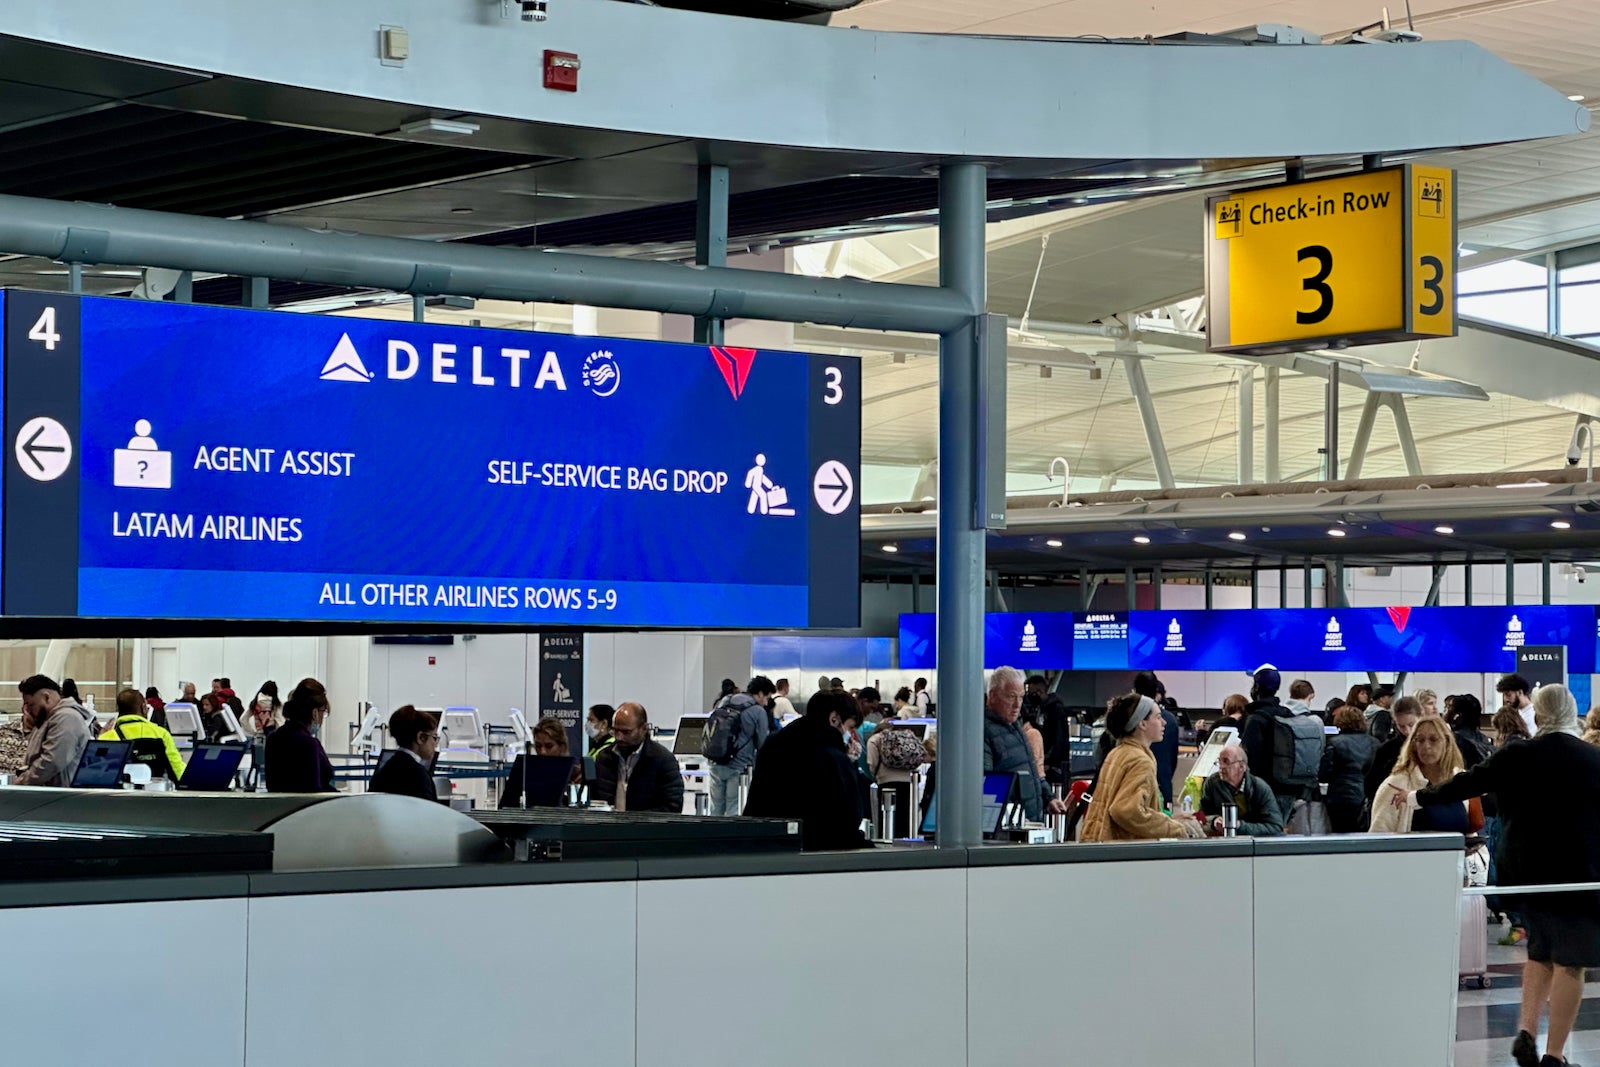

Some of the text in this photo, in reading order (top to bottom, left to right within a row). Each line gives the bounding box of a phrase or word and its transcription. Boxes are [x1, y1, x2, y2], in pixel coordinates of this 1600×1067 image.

[1249, 191, 1390, 225] Check-in Row
[1296, 245, 1334, 325] 3
[1419, 255, 1445, 316] 3
[28, 307, 60, 350] 4
[386, 339, 567, 391] DELTA
[582, 350, 613, 387] SKYTEAM
[823, 367, 843, 405] 3
[194, 446, 355, 477] AGENT ASSIST
[487, 460, 728, 494] SELF-SERVICE BAG DROP
[113, 512, 303, 542] LATAM AIRLINES
[319, 583, 617, 611] ALL OTHER AIRLINES ROWS 5-9
[550, 638, 574, 646] DELTA
[1528, 653, 1553, 661] DELTA
[543, 709, 580, 718] SELF-SERVICE
